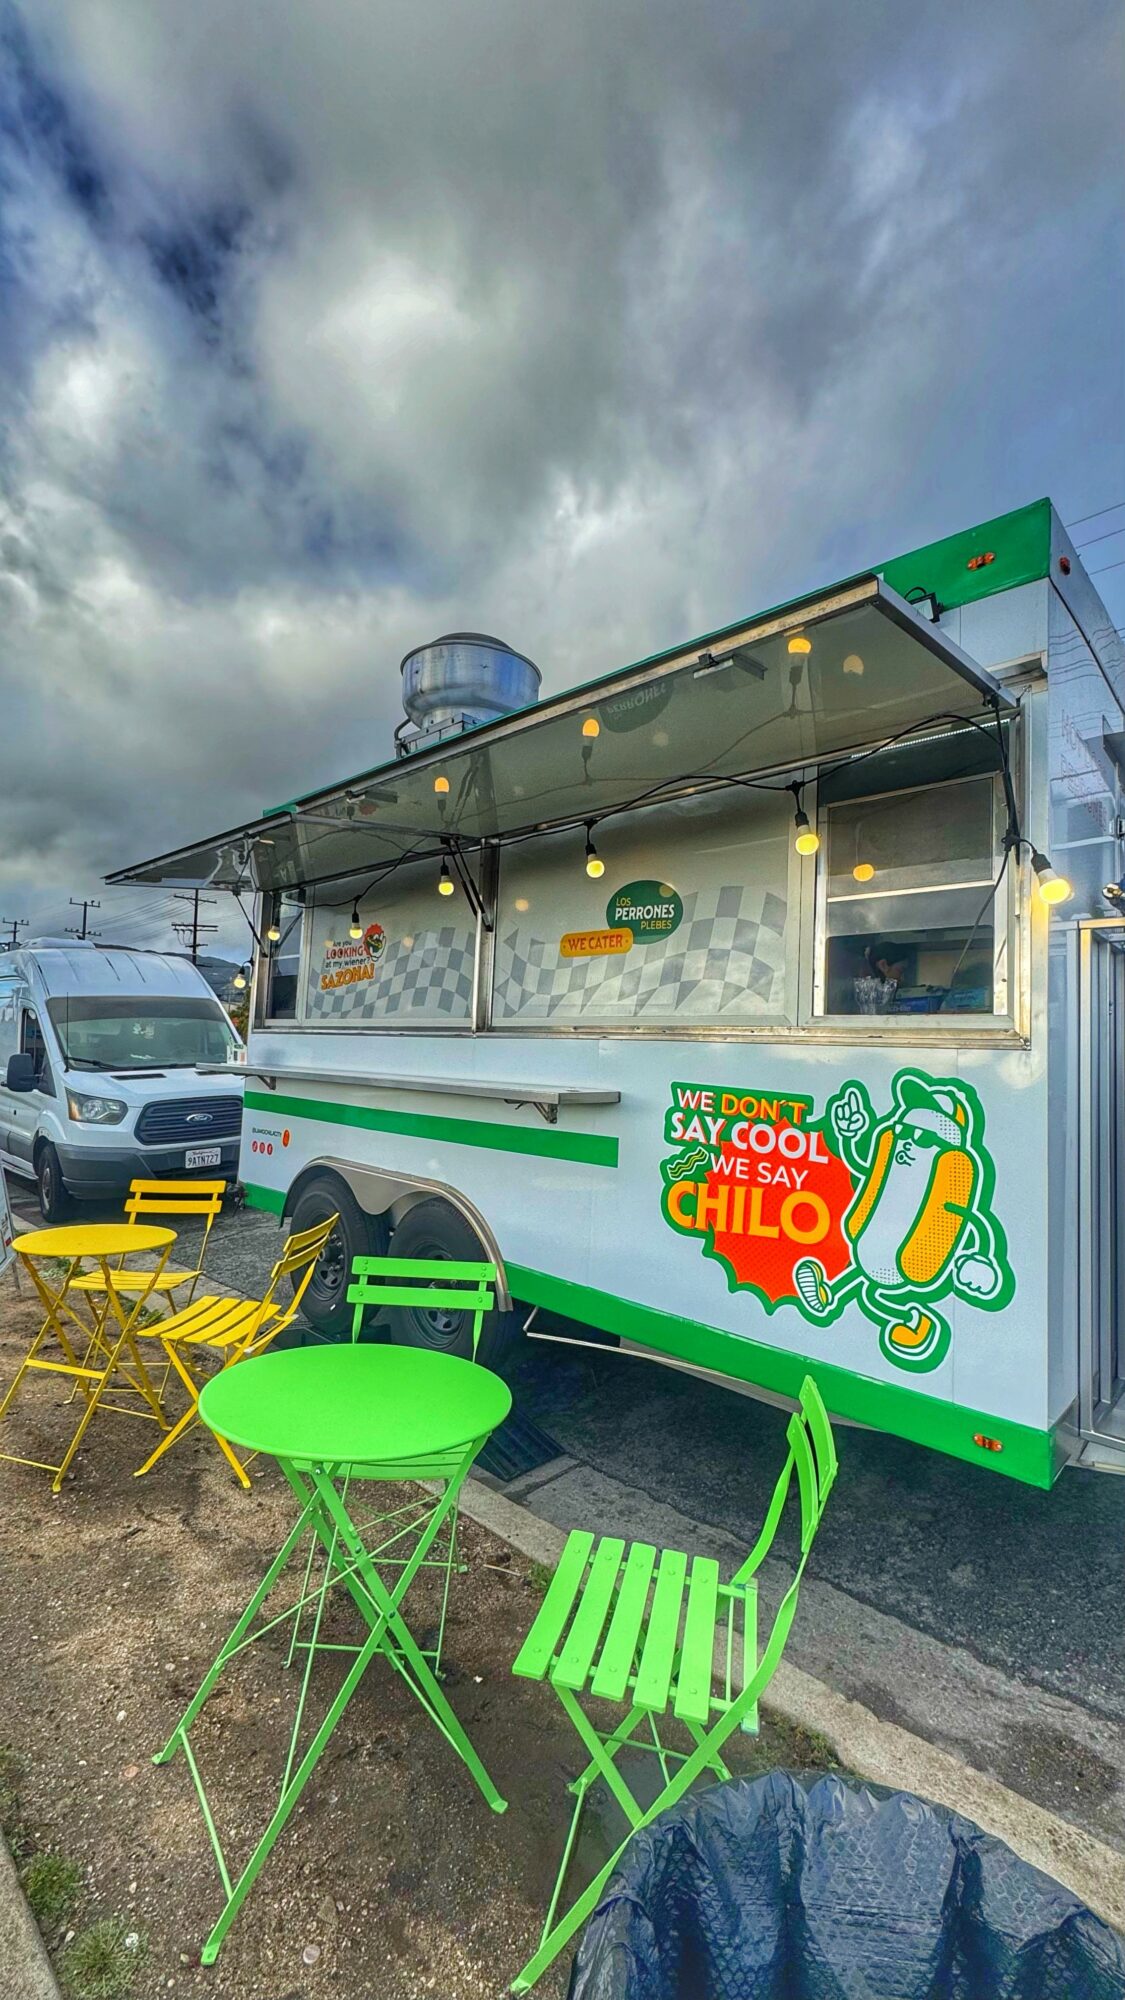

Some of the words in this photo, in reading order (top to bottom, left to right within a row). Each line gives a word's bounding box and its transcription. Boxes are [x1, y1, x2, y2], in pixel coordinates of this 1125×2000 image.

[616, 897, 631, 906] LOS
[615, 904, 675, 921] PERRONES
[640, 919, 672, 930] PLEBES
[568, 938, 587, 951] WE
[589, 934, 623, 950] CATER
[326, 945, 364, 960] LOOKING
[333, 961, 342, 969] my
[344, 957, 370, 967] wiener?
[321, 963, 375, 990] SAZONA!
[677, 1087, 714, 1113] WE
[721, 1094, 807, 1124] DON'T
[670, 1111, 728, 1147] SAY
[731, 1121, 829, 1164] COOL
[187, 1153, 219, 1167] 9ATN727
[710, 1154, 750, 1180] WE
[757, 1161, 809, 1190] SAY
[667, 1181, 831, 1245] CHILO
